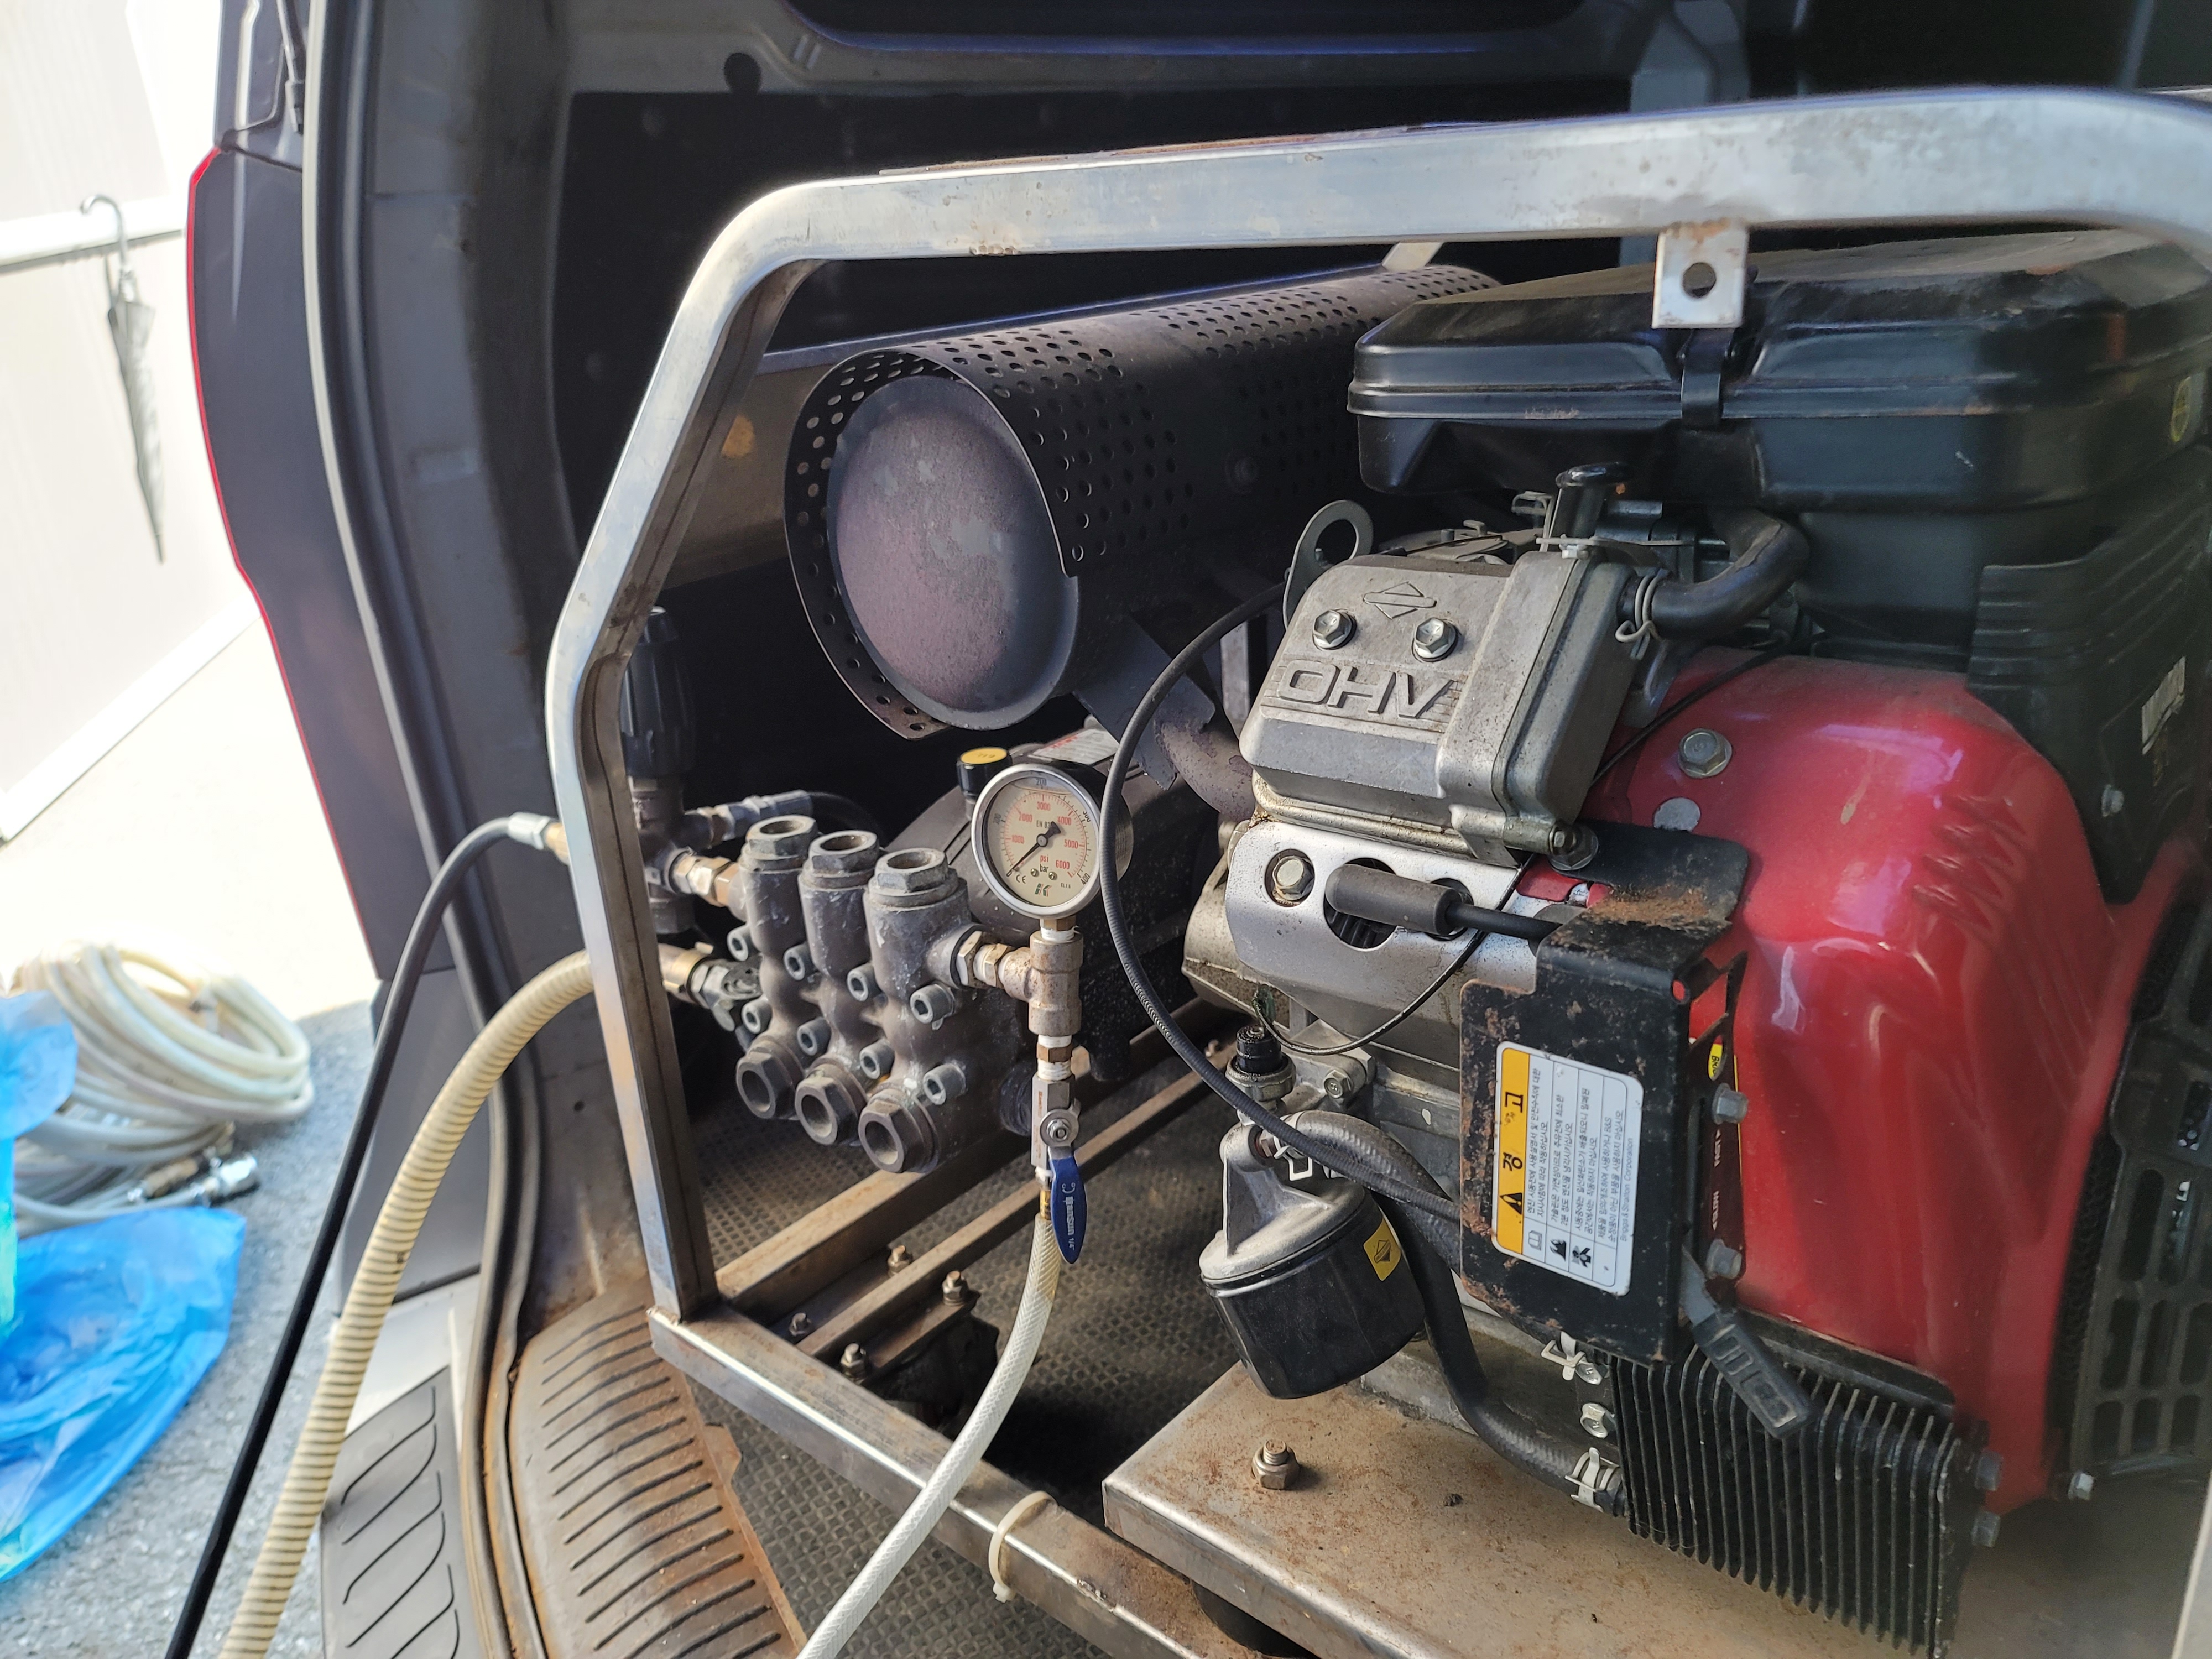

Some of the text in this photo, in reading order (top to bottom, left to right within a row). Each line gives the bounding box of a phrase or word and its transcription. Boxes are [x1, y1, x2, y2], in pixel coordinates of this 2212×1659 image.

[1276, 660, 1454, 719] OHV
[1019, 813, 1032, 822] 2000
[1037, 801, 1051, 811] 3000
[1058, 816, 1072, 825] 4000
[1012, 835, 1025, 844] 1000
[1064, 841, 1078, 849] 5000
[1016, 874, 1026, 884] CE
[1040, 864, 1049, 873] bar
[1056, 860, 1070, 869] 6000
[1081, 873, 1091, 885] 400
[1553, 1118, 1562, 1149] 주유전에
[1614, 1108, 1624, 1140] 마십시오
[1528, 1131, 1537, 1168] 사용설명서
[1601, 1133, 1611, 1171] 사용하거나
[1612, 1141, 1621, 1172] 사용하지
[1623, 1136, 1634, 1182] Corporation
[1537, 1119, 1548, 1218] 지시사항에 따라 작동하십시오
[1552, 1149, 1561, 1192] 가연성이므로
[1561, 1121, 1573, 1227] 2분 정도 엔진을 냉각시키십시오
[1528, 1169, 1536, 1199] 시동전에
[1585, 1135, 1597, 1235] 공간에서는 작동하지 마십시오
[1527, 1198, 1535, 1215] 엔진
[1551, 1193, 1559, 1223] 가솔린은
